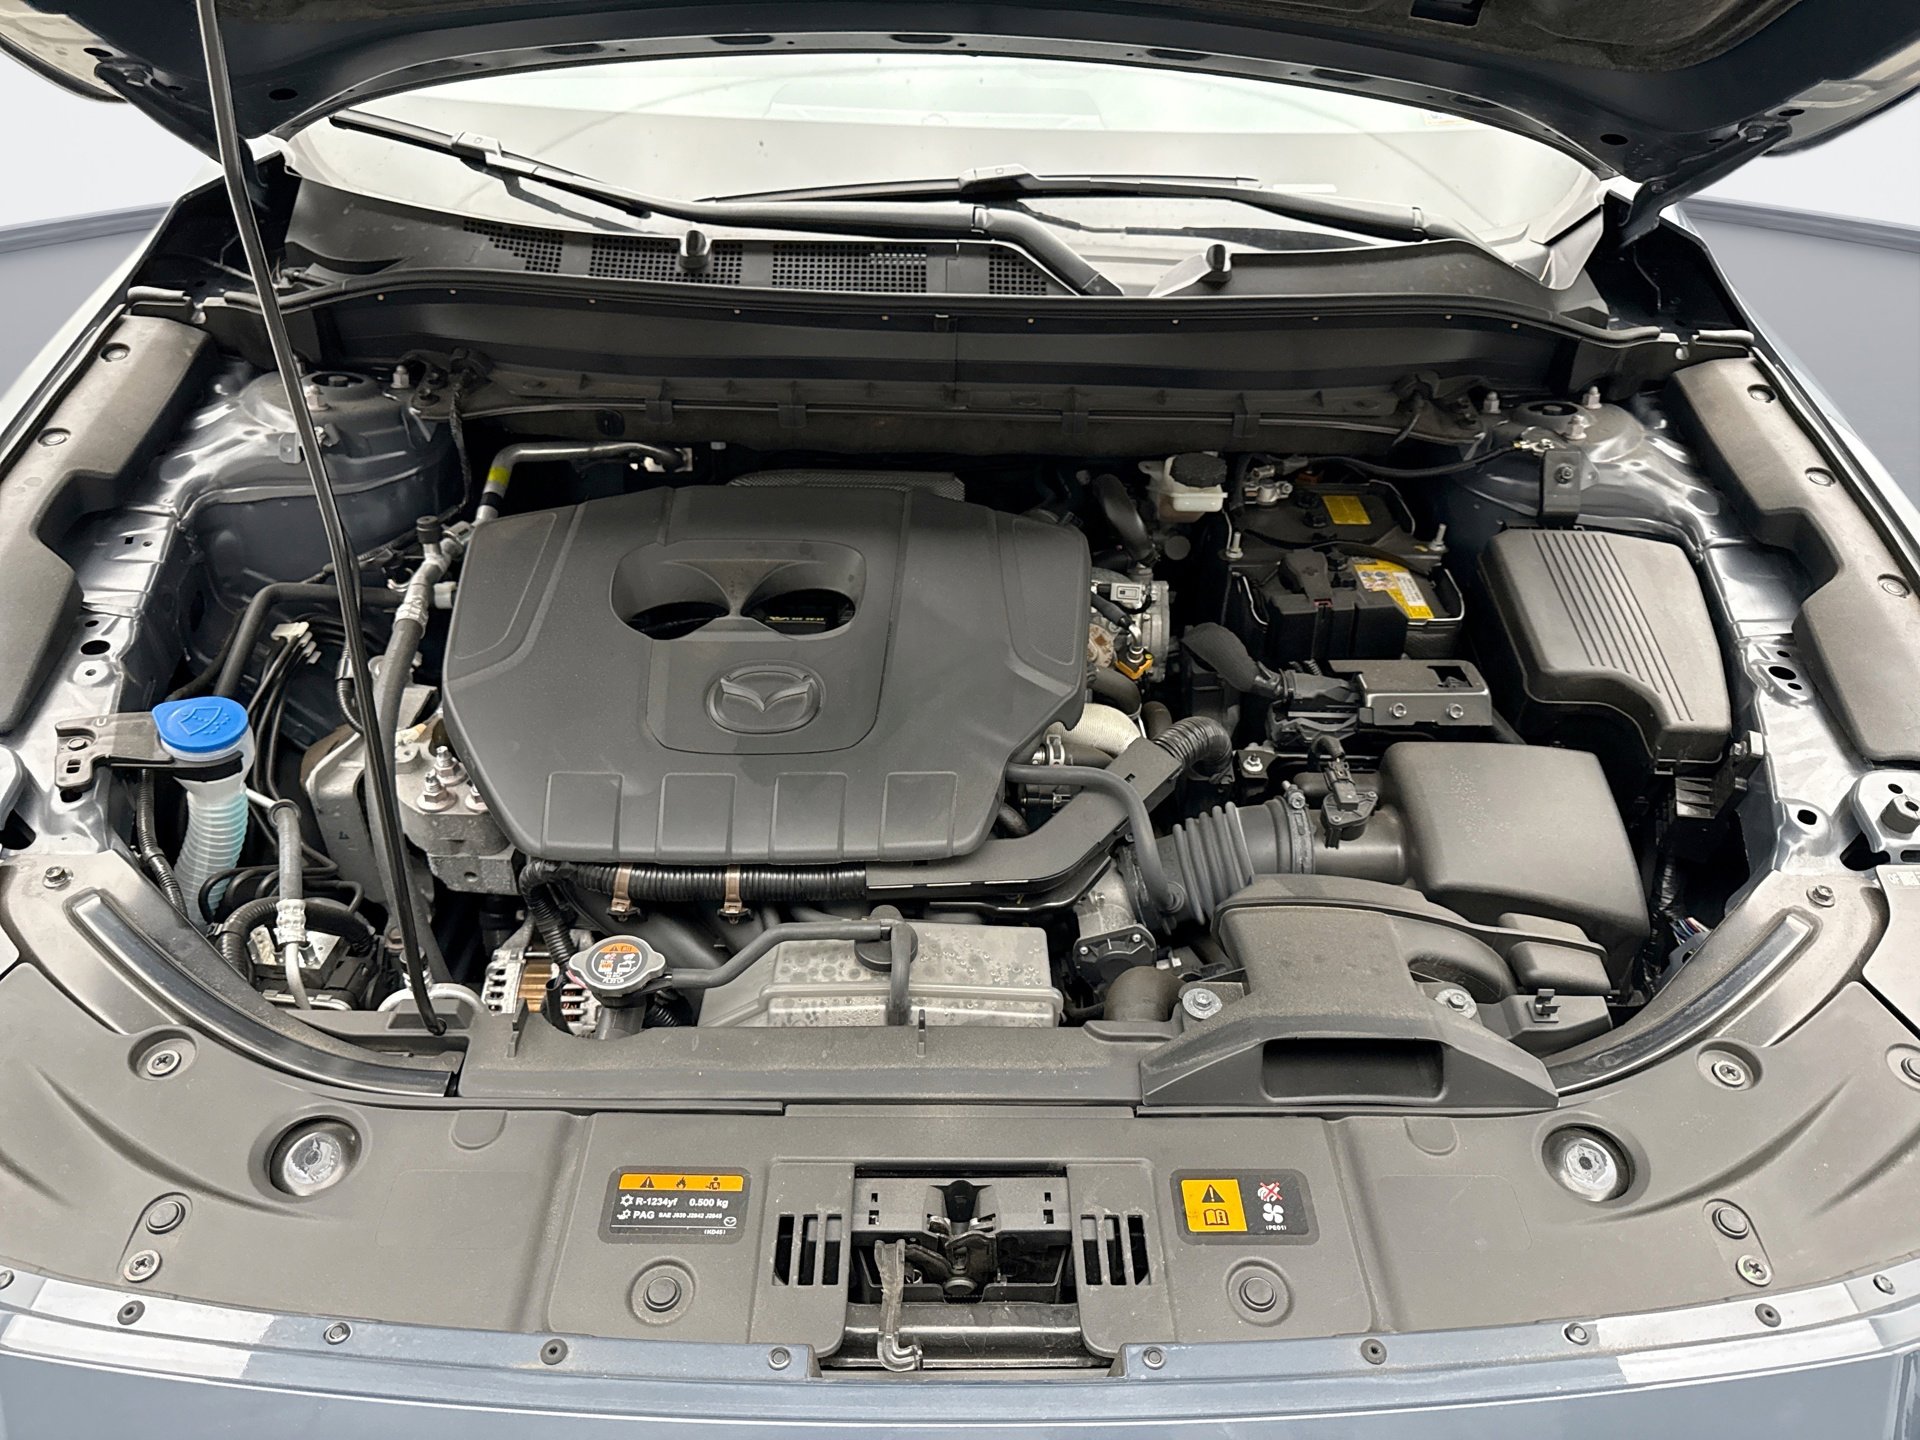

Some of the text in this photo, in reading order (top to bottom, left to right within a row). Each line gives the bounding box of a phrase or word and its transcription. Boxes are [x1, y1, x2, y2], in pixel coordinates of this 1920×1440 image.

[635, 1197, 729, 1209] R-1234yf 0.500 kg
[633, 1210, 655, 1219] PAG
